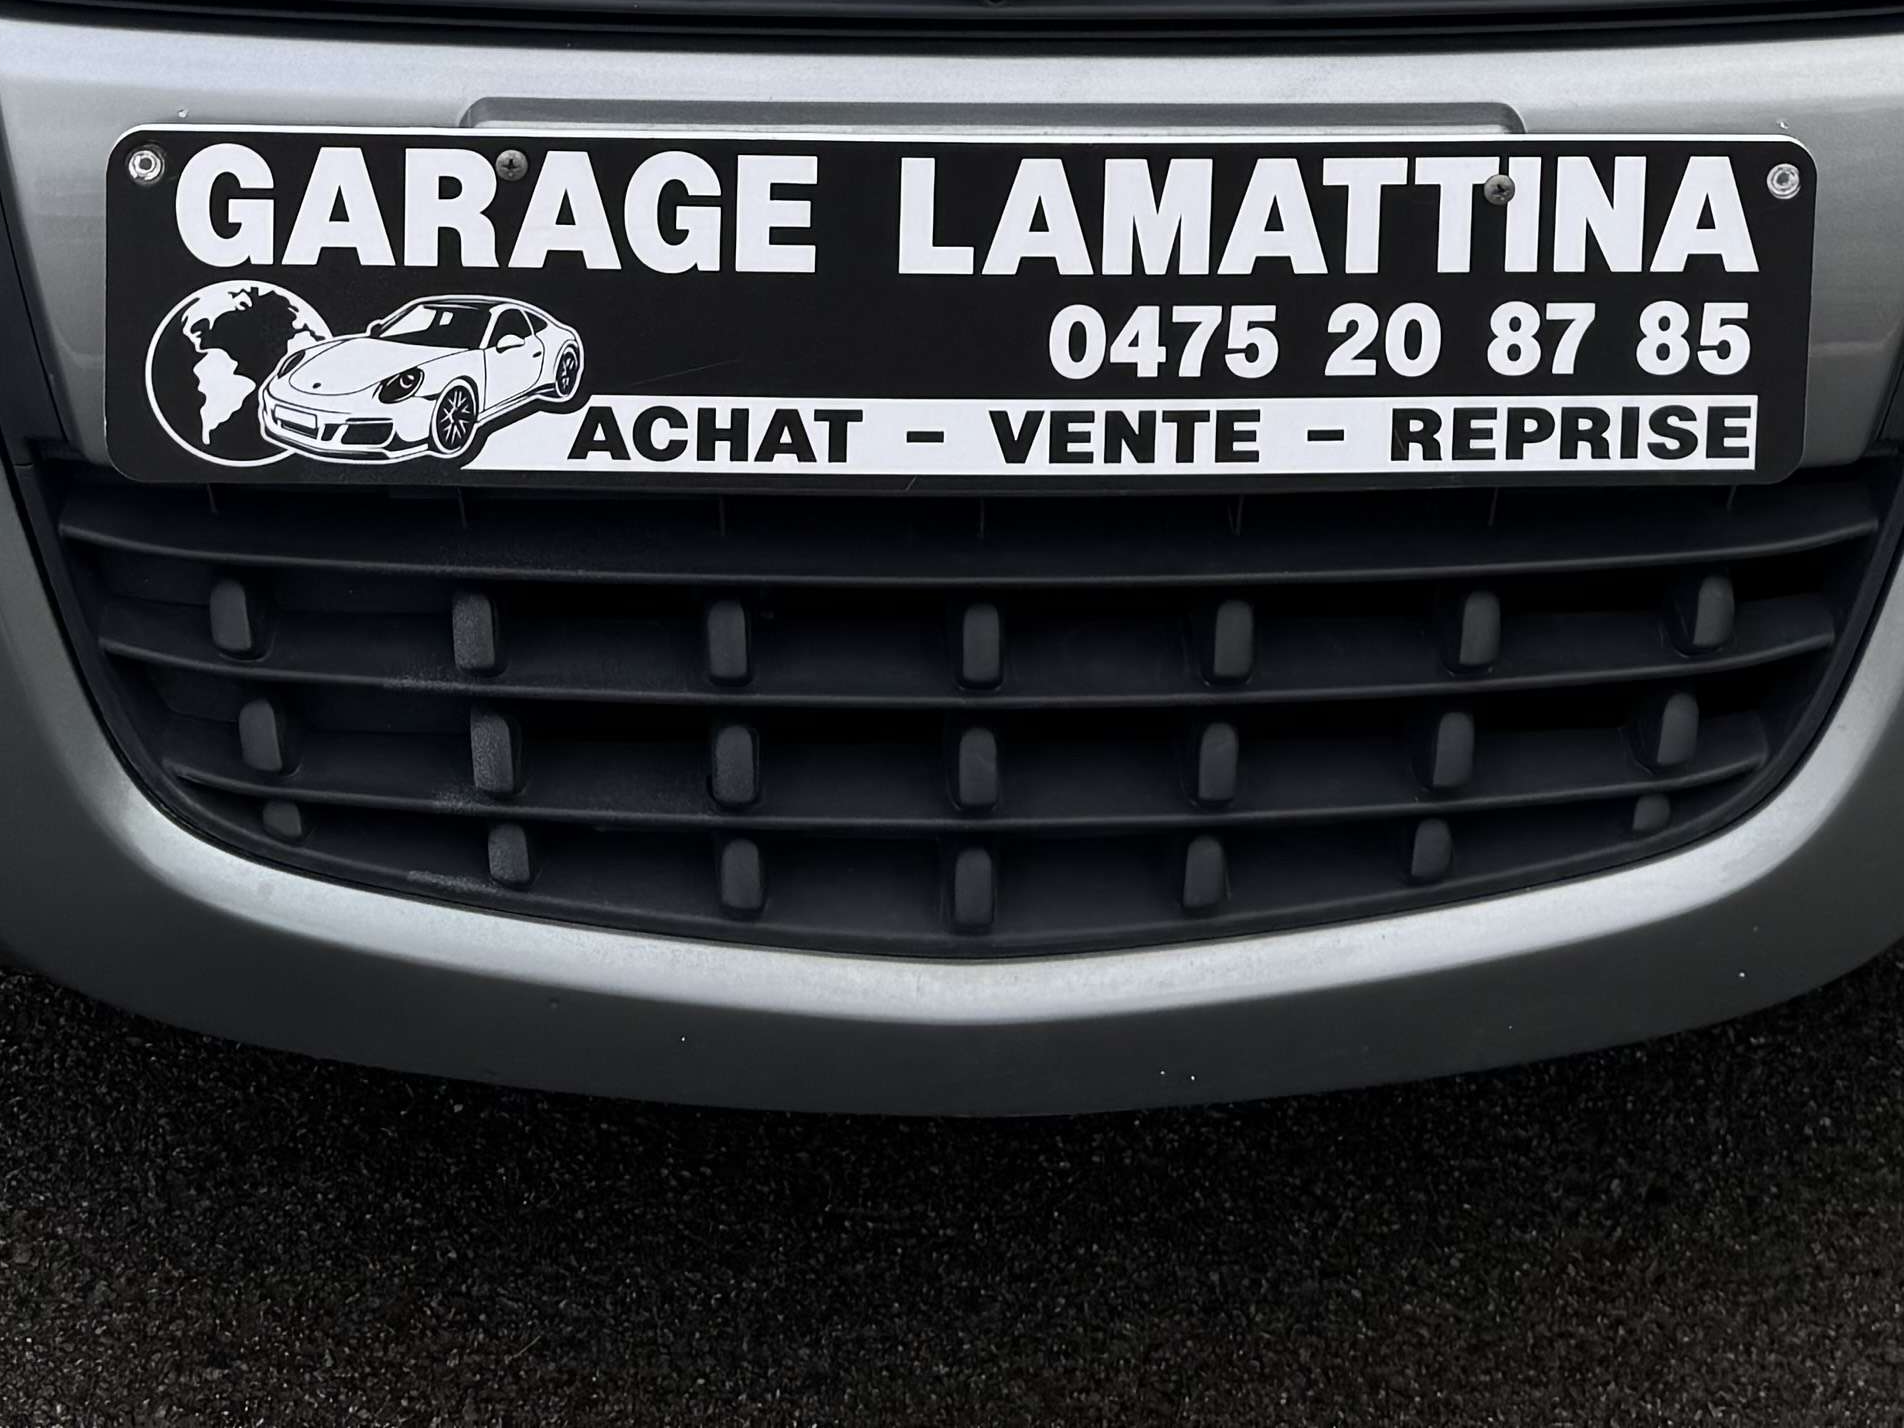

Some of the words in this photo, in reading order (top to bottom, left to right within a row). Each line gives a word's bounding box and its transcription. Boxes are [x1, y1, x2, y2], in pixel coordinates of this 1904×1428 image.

[175, 143, 819, 275] GARAGE
[899, 156, 1759, 275] LAMATTINA
[1048, 304, 1279, 380] 0475
[1325, 304, 1442, 378] 20
[1486, 302, 1596, 377] 87
[1636, 302, 1751, 377] 85
[567, 407, 863, 464] ACHAT
[990, 410, 1261, 464] VENTE
[1391, 405, 1754, 461] REPRISE
